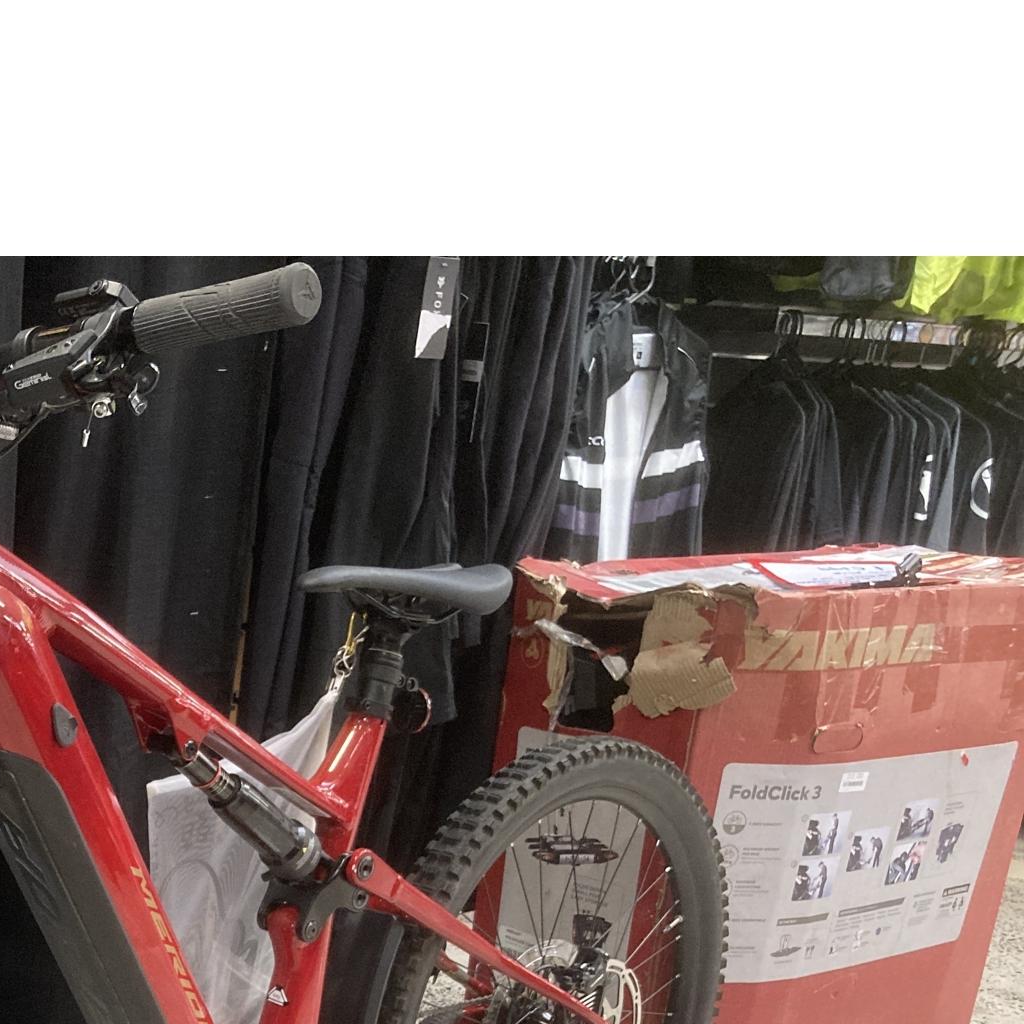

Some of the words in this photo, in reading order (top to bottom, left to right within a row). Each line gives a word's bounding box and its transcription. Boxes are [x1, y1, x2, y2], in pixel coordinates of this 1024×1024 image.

[737, 623, 936, 671] YAKIMA
[729, 784, 810, 801] FoldClick
[811, 785, 823, 800] 3
